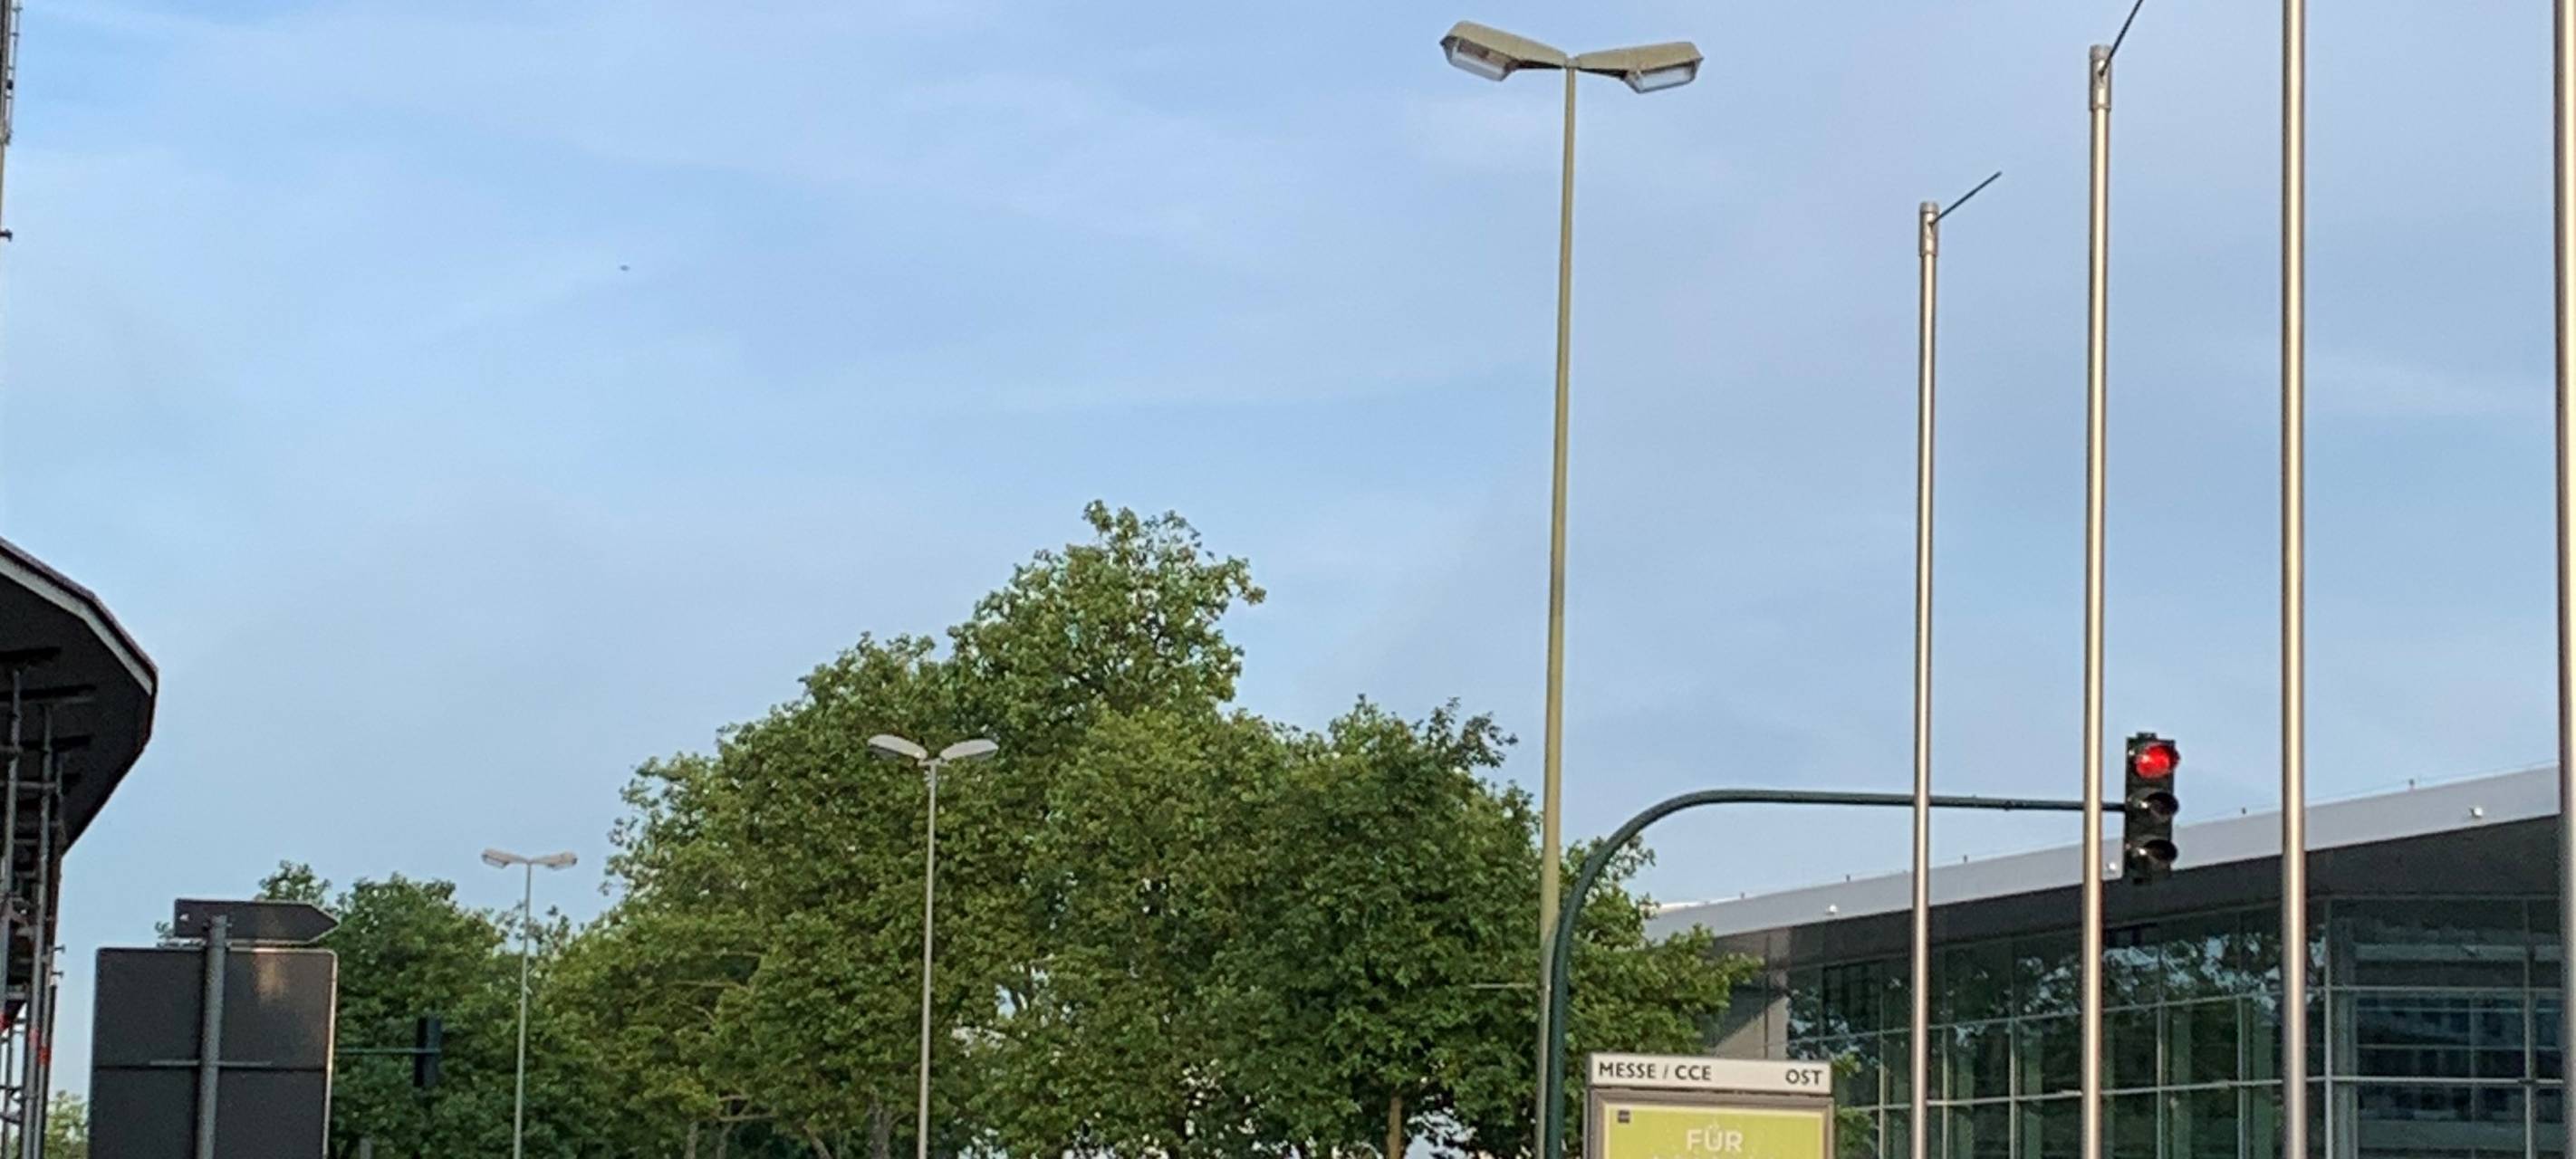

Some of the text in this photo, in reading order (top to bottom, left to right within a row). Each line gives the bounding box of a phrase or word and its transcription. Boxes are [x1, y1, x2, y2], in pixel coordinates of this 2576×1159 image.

[1599, 1061, 1657, 1078] MESSE
[1675, 1065, 1712, 1081] CCE
[1785, 1068, 1823, 1085] OST
[1686, 1125, 1744, 1152] FÜR
